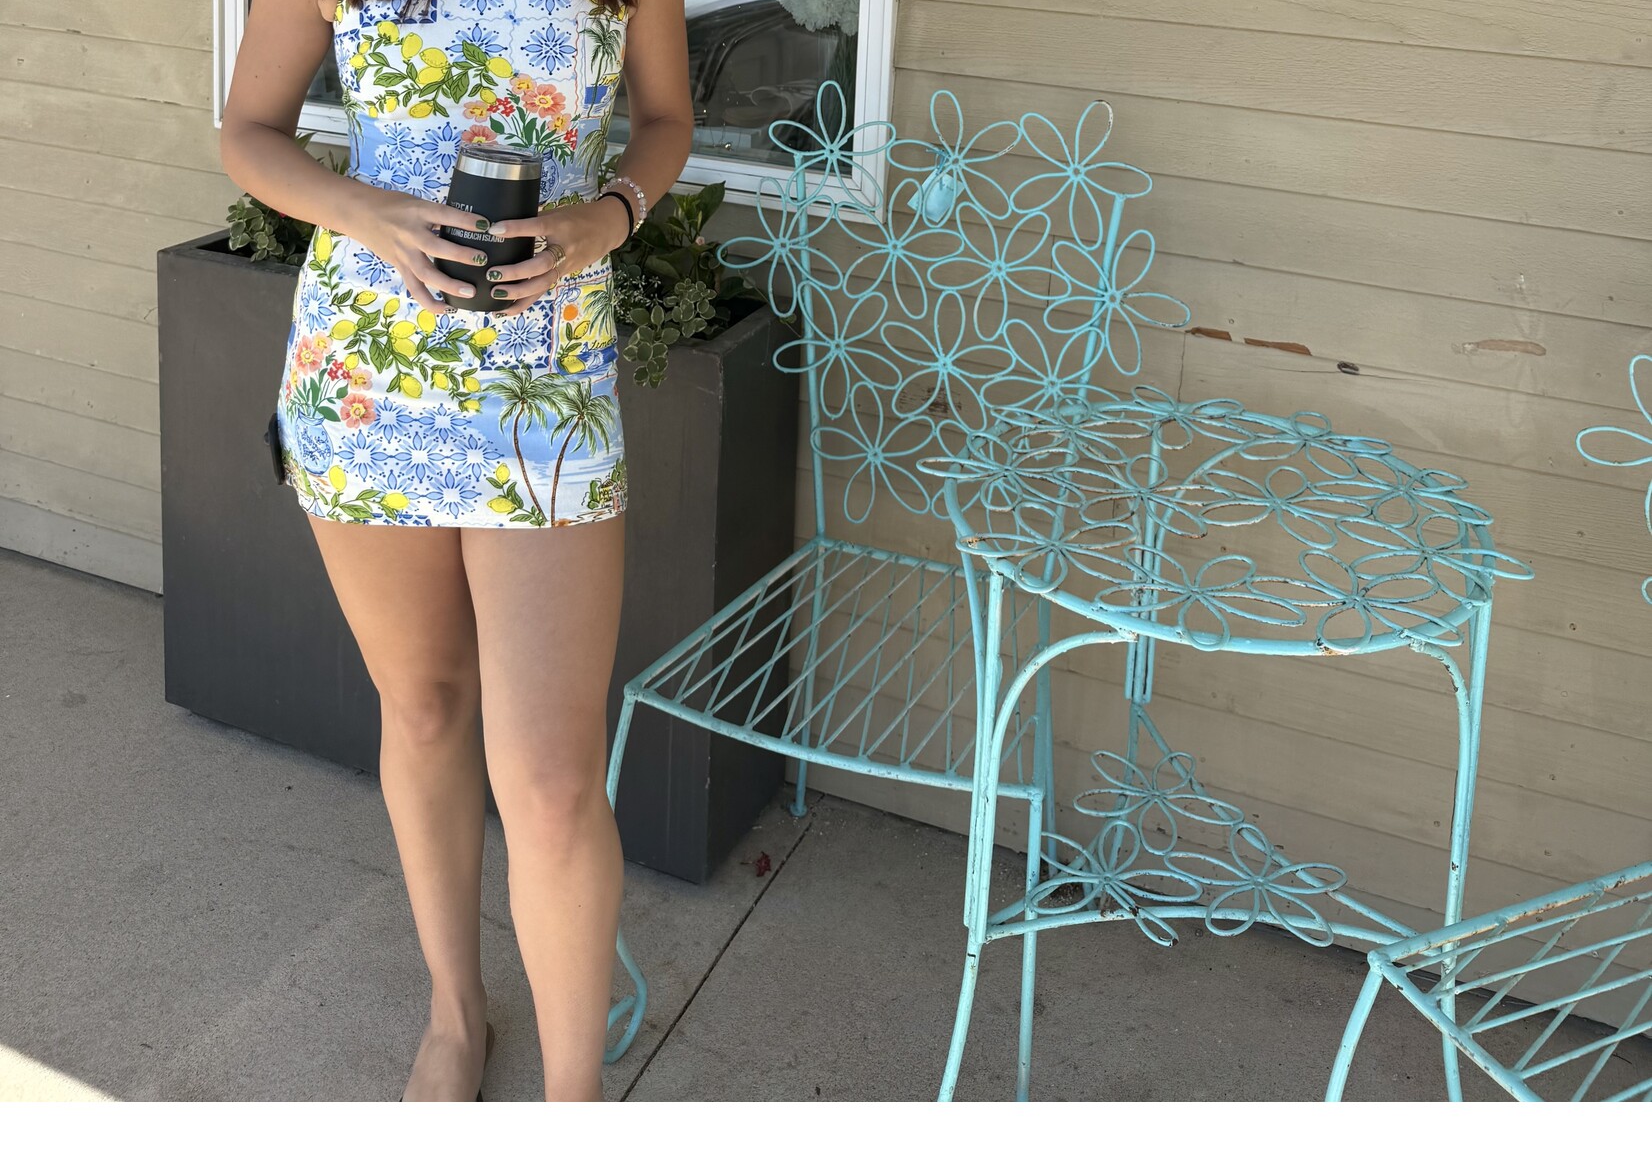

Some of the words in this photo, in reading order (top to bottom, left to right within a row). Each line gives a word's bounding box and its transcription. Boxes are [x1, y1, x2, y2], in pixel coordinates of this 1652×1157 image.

[450, 227, 464, 237] LONG
[463, 231, 482, 241] BEACH
[482, 234, 505, 243] ISLAND
